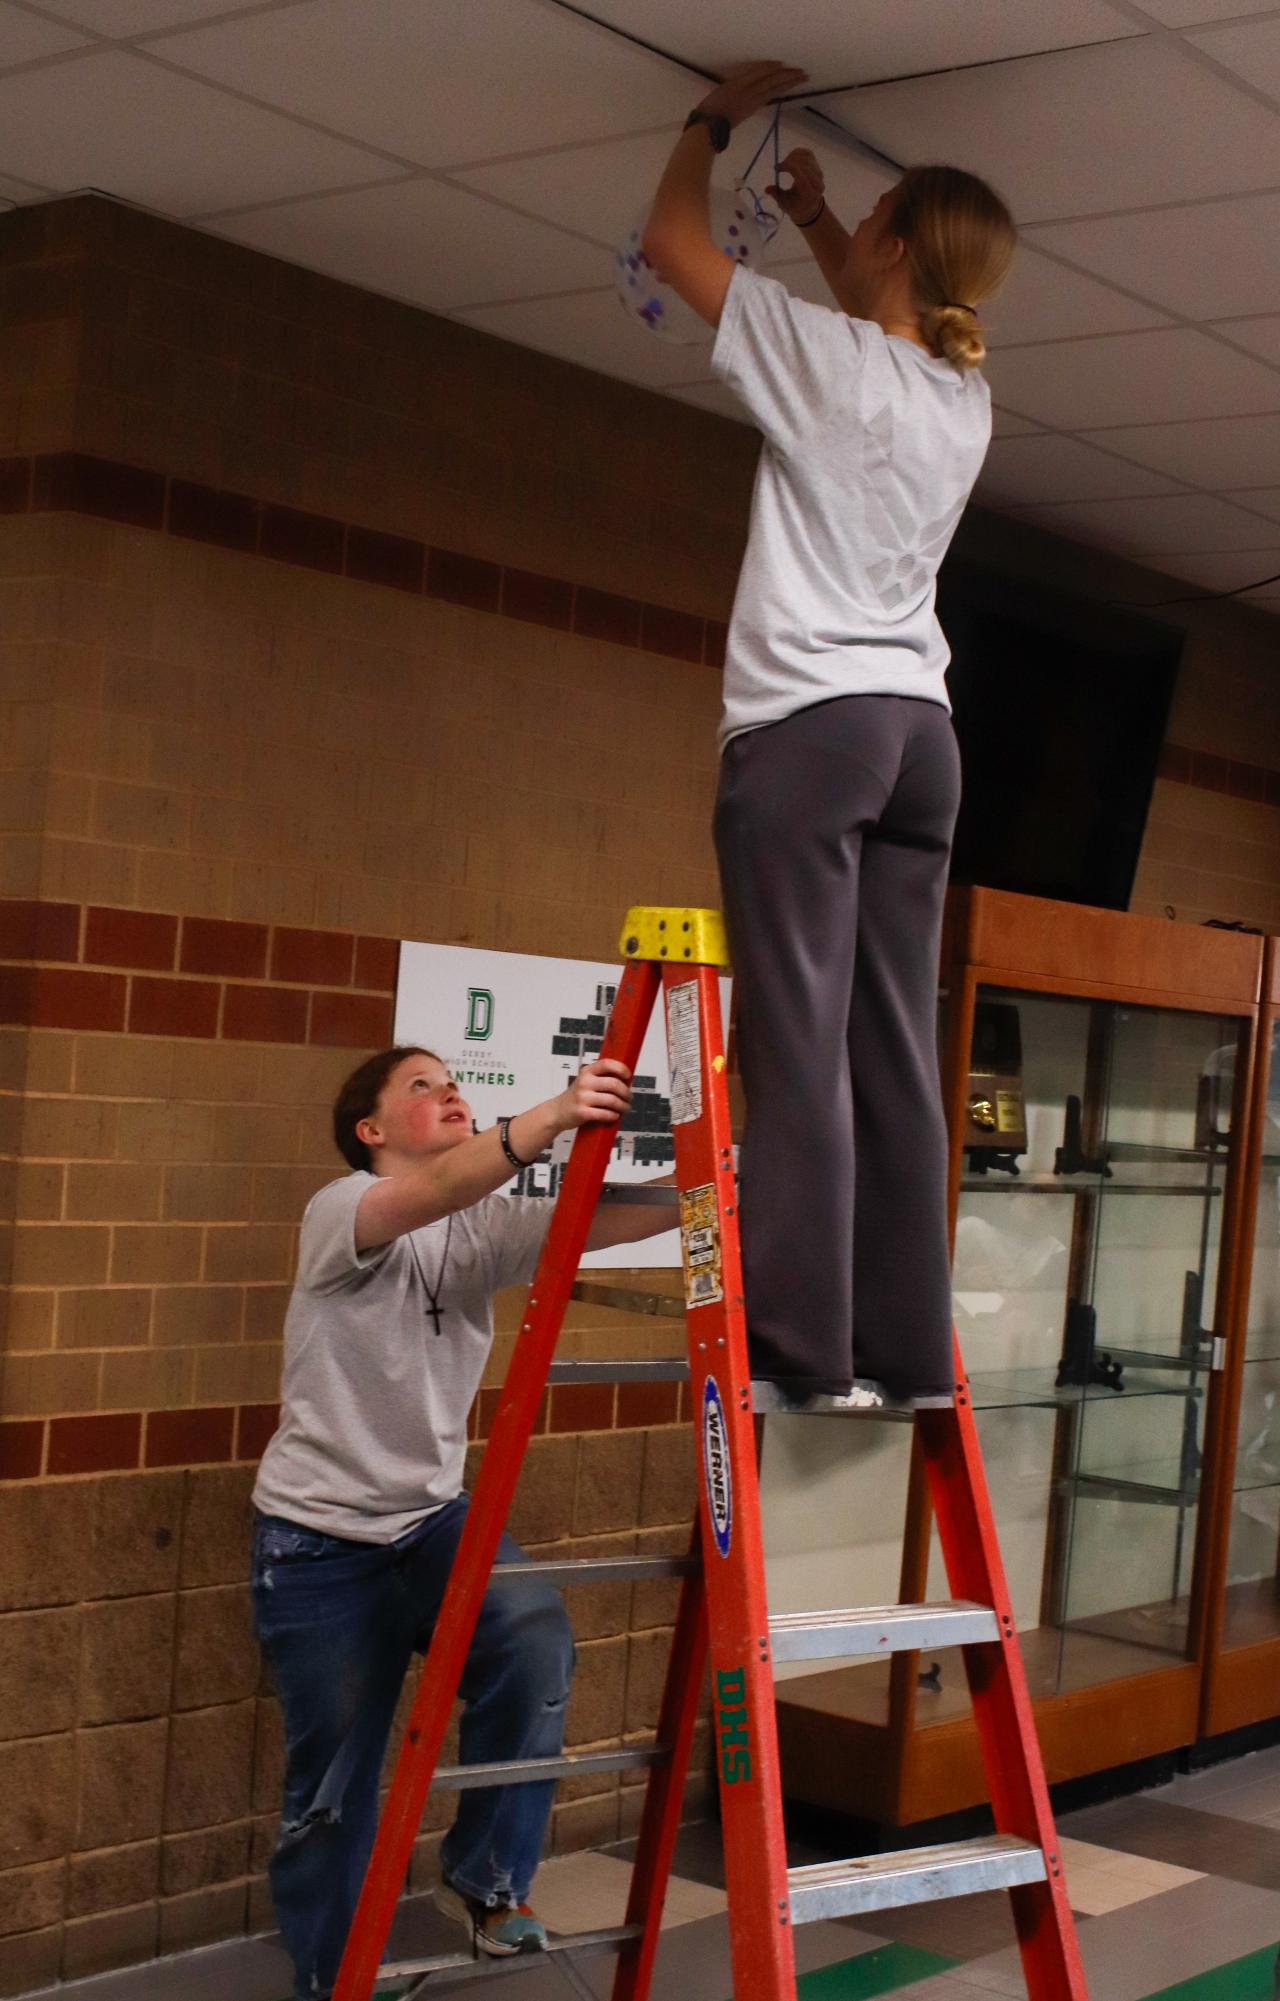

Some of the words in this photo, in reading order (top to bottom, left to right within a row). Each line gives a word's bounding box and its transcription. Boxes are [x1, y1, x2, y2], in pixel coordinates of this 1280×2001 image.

[464, 987, 495, 1041] D
[708, 1412, 726, 1521] WERNER
[717, 1666, 751, 1784] DHS
